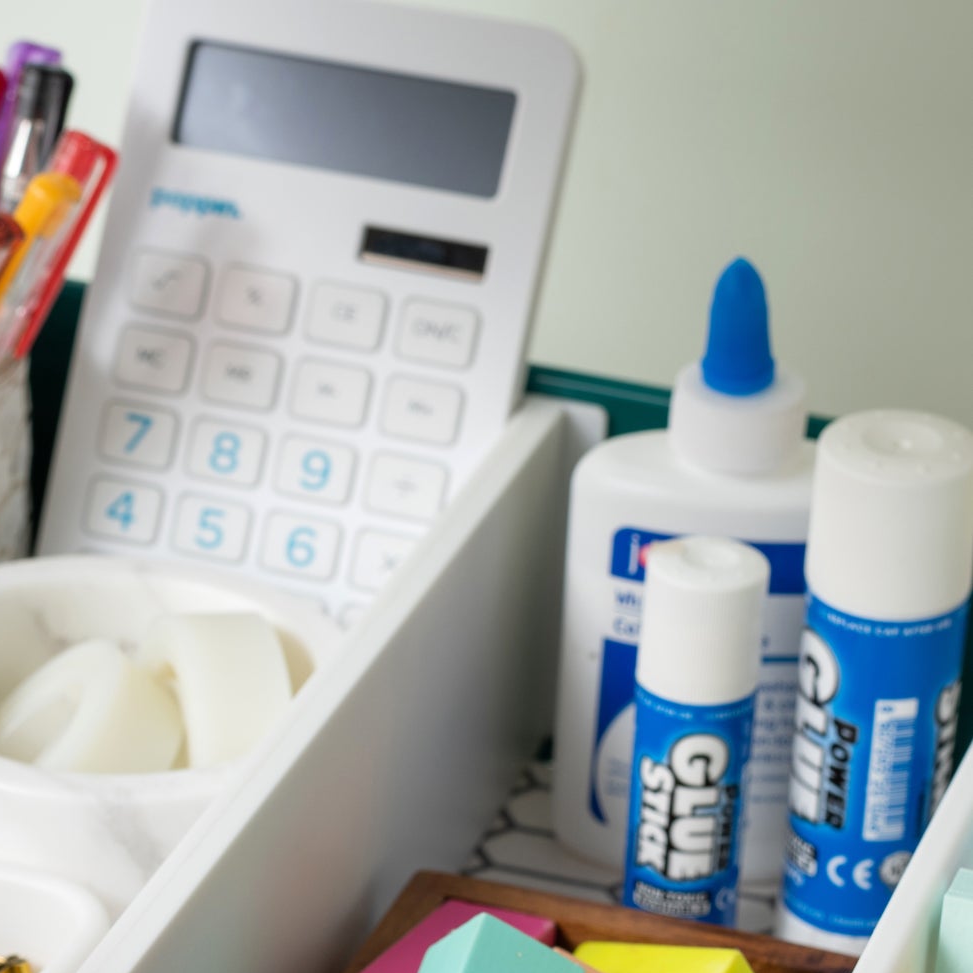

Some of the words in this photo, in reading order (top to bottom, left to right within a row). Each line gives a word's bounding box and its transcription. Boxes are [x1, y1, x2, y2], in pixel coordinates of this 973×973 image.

[123, 412, 152, 455] 7
[208, 432, 241, 475] 8
[300, 449, 331, 492] 9
[105, 491, 136, 531] 4
[193, 507, 226, 550] 5
[285, 526, 317, 569] 6
[789, 628, 839, 826] GLUE
[824, 716, 859, 831] POWER
[638, 757, 674, 878] STICK
[667, 732, 729, 884] GLUE
